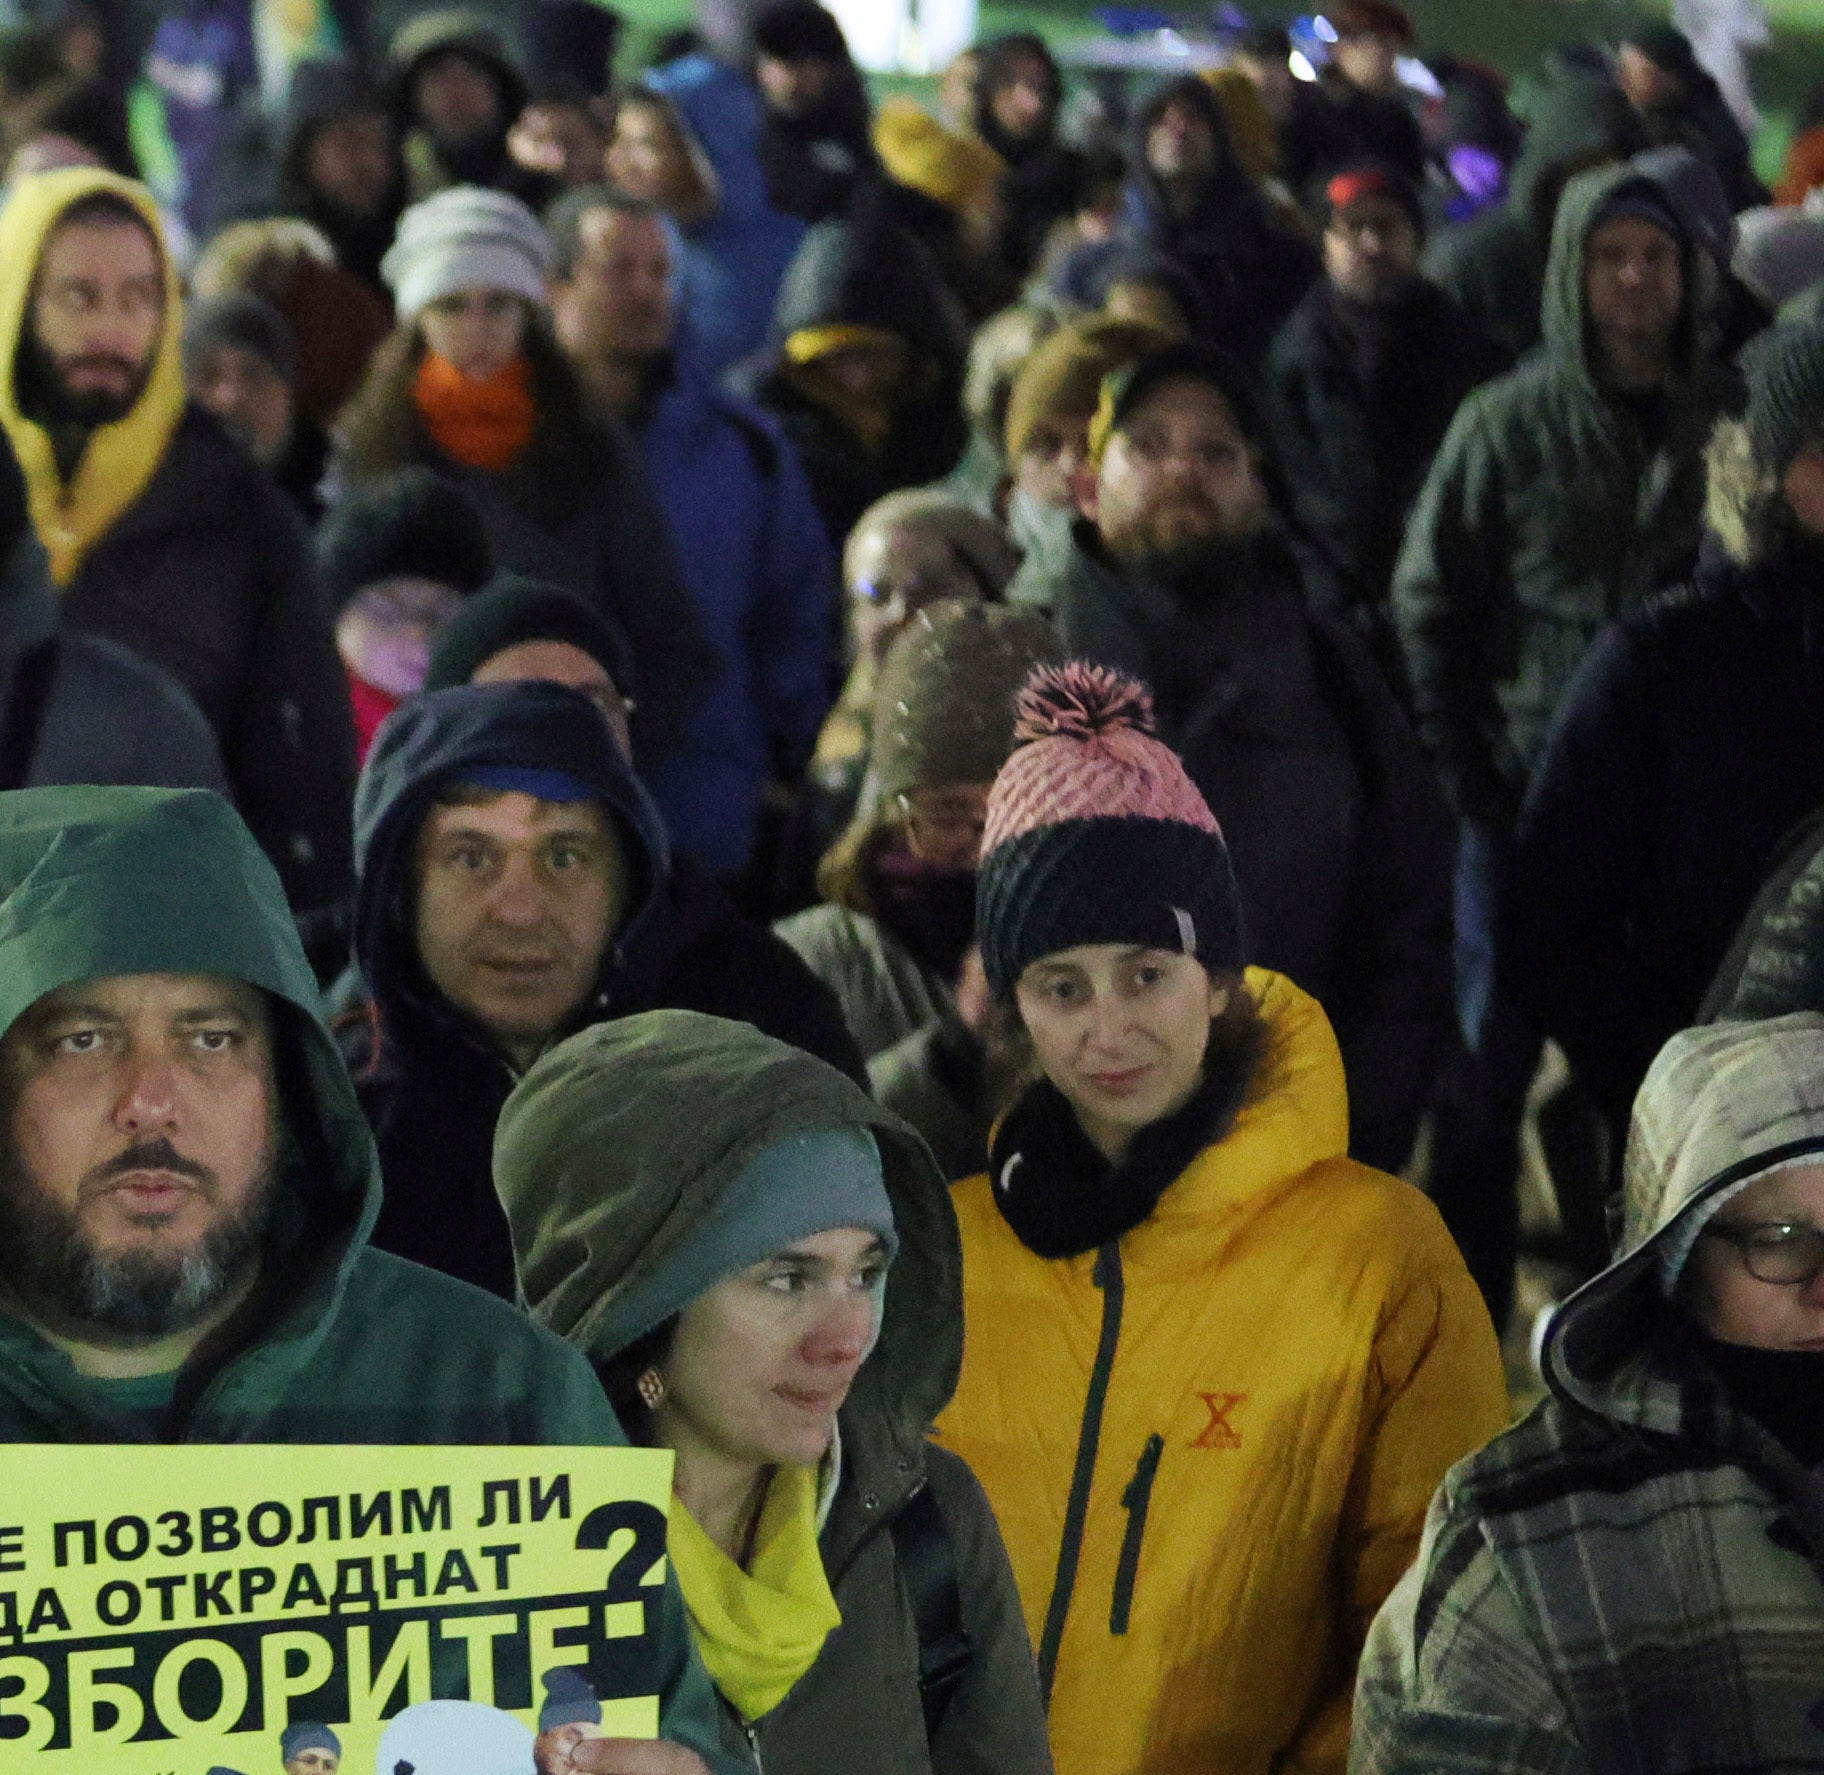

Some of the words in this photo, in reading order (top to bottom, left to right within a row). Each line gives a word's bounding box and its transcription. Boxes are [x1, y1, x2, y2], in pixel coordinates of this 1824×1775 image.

[54, 1484, 452, 1568] ПОЗВОЛИМ
[477, 1473, 573, 1527] ЛИ
[96, 1542, 522, 1626] ОТКРАДНАТ
